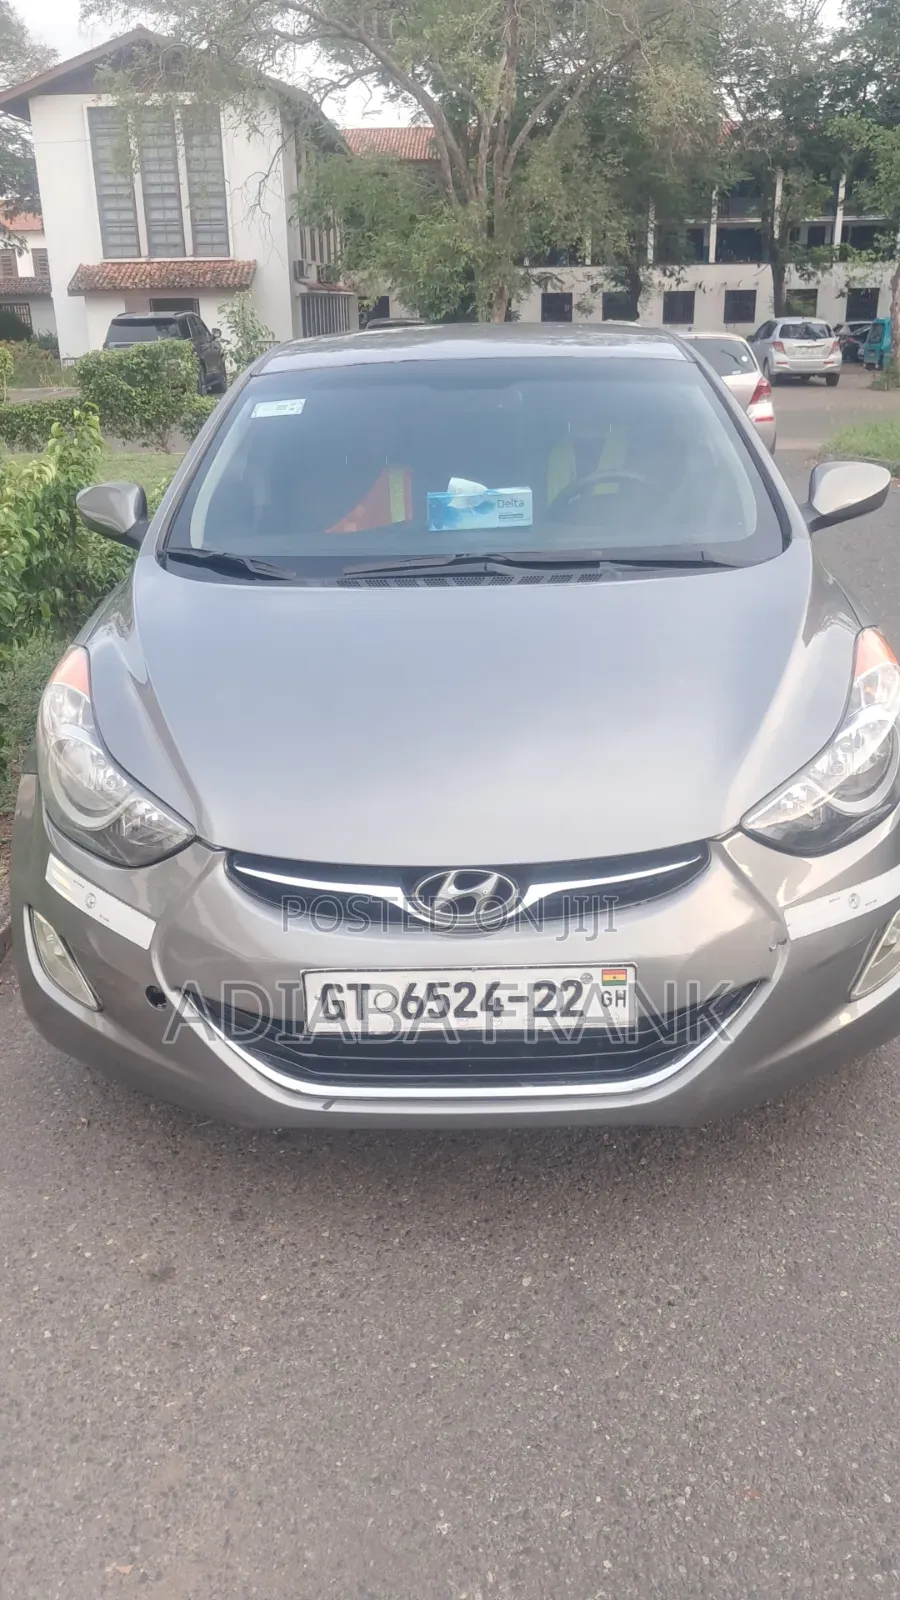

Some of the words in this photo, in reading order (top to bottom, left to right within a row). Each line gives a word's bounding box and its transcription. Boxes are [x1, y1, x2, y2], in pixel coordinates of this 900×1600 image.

[497, 498, 524, 508] Delta
[320, 983, 371, 1020] GT
[400, 980, 584, 1019] 6524-22
[600, 990, 627, 1008] GH
